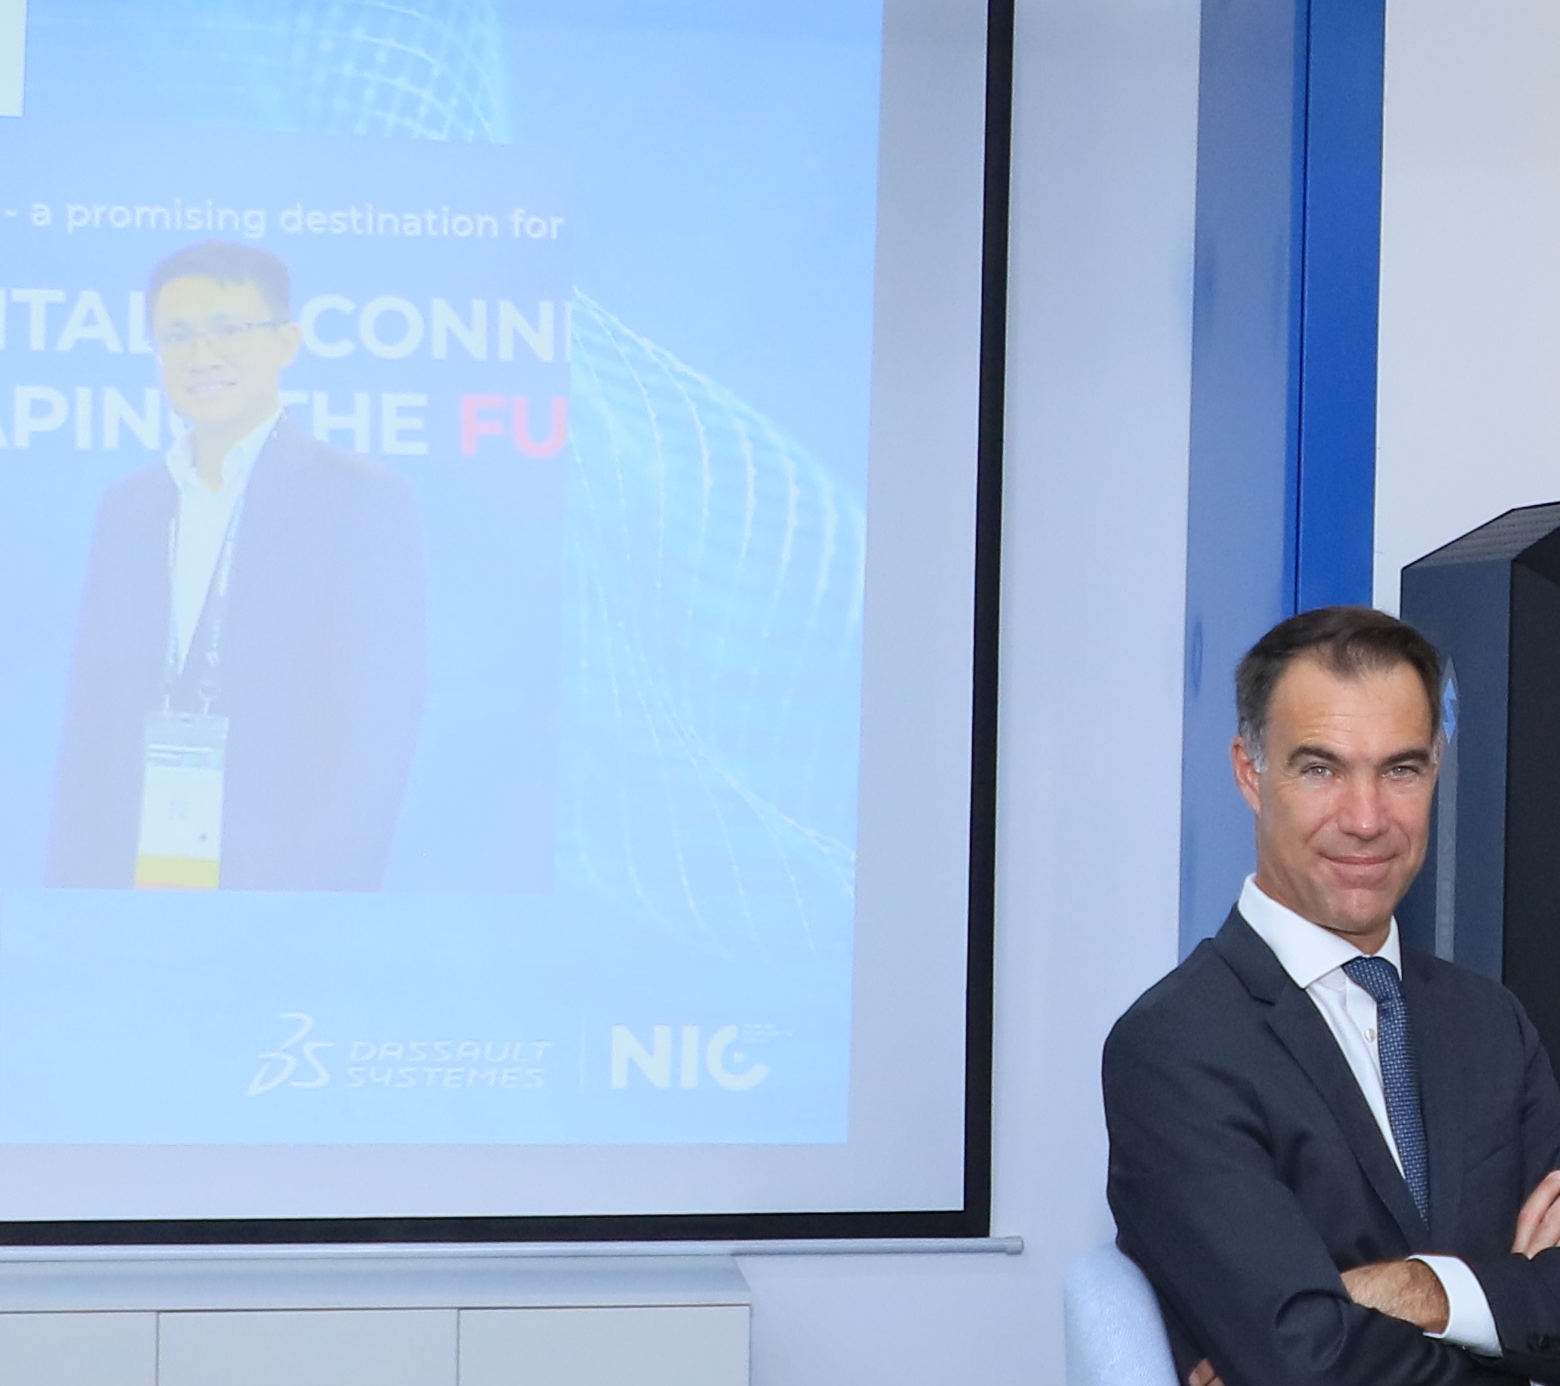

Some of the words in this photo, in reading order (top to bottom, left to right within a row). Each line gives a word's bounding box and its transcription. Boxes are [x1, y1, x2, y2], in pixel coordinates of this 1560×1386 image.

[30, 202, 52, 227] a
[67, 195, 264, 239] promising
[278, 202, 499, 238] destination
[509, 207, 565, 240] for
[299, 293, 573, 363] CONN
[348, 1039, 554, 1063] DASSAULT
[611, 1024, 771, 1091] NIC
